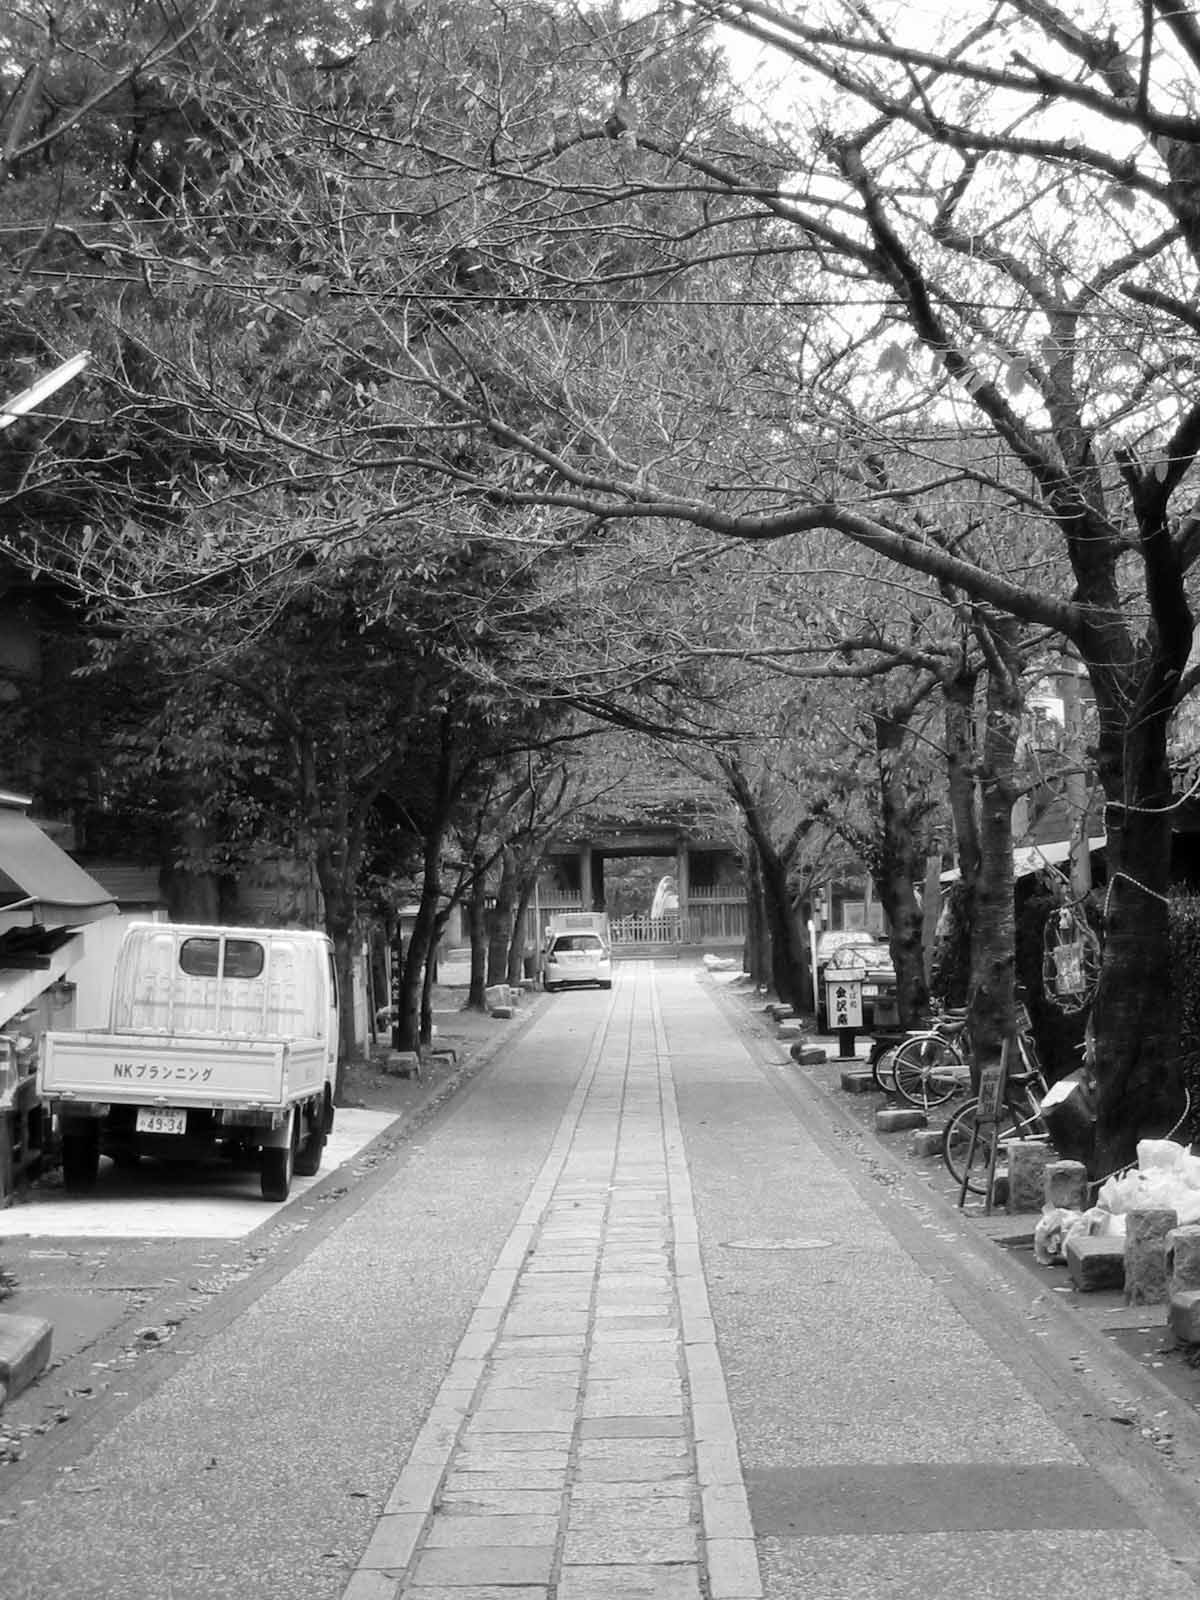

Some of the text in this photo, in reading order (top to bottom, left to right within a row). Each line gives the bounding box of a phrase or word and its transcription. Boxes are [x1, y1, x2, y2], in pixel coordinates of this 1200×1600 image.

[113, 1063, 213, 1082] NKプランニング
